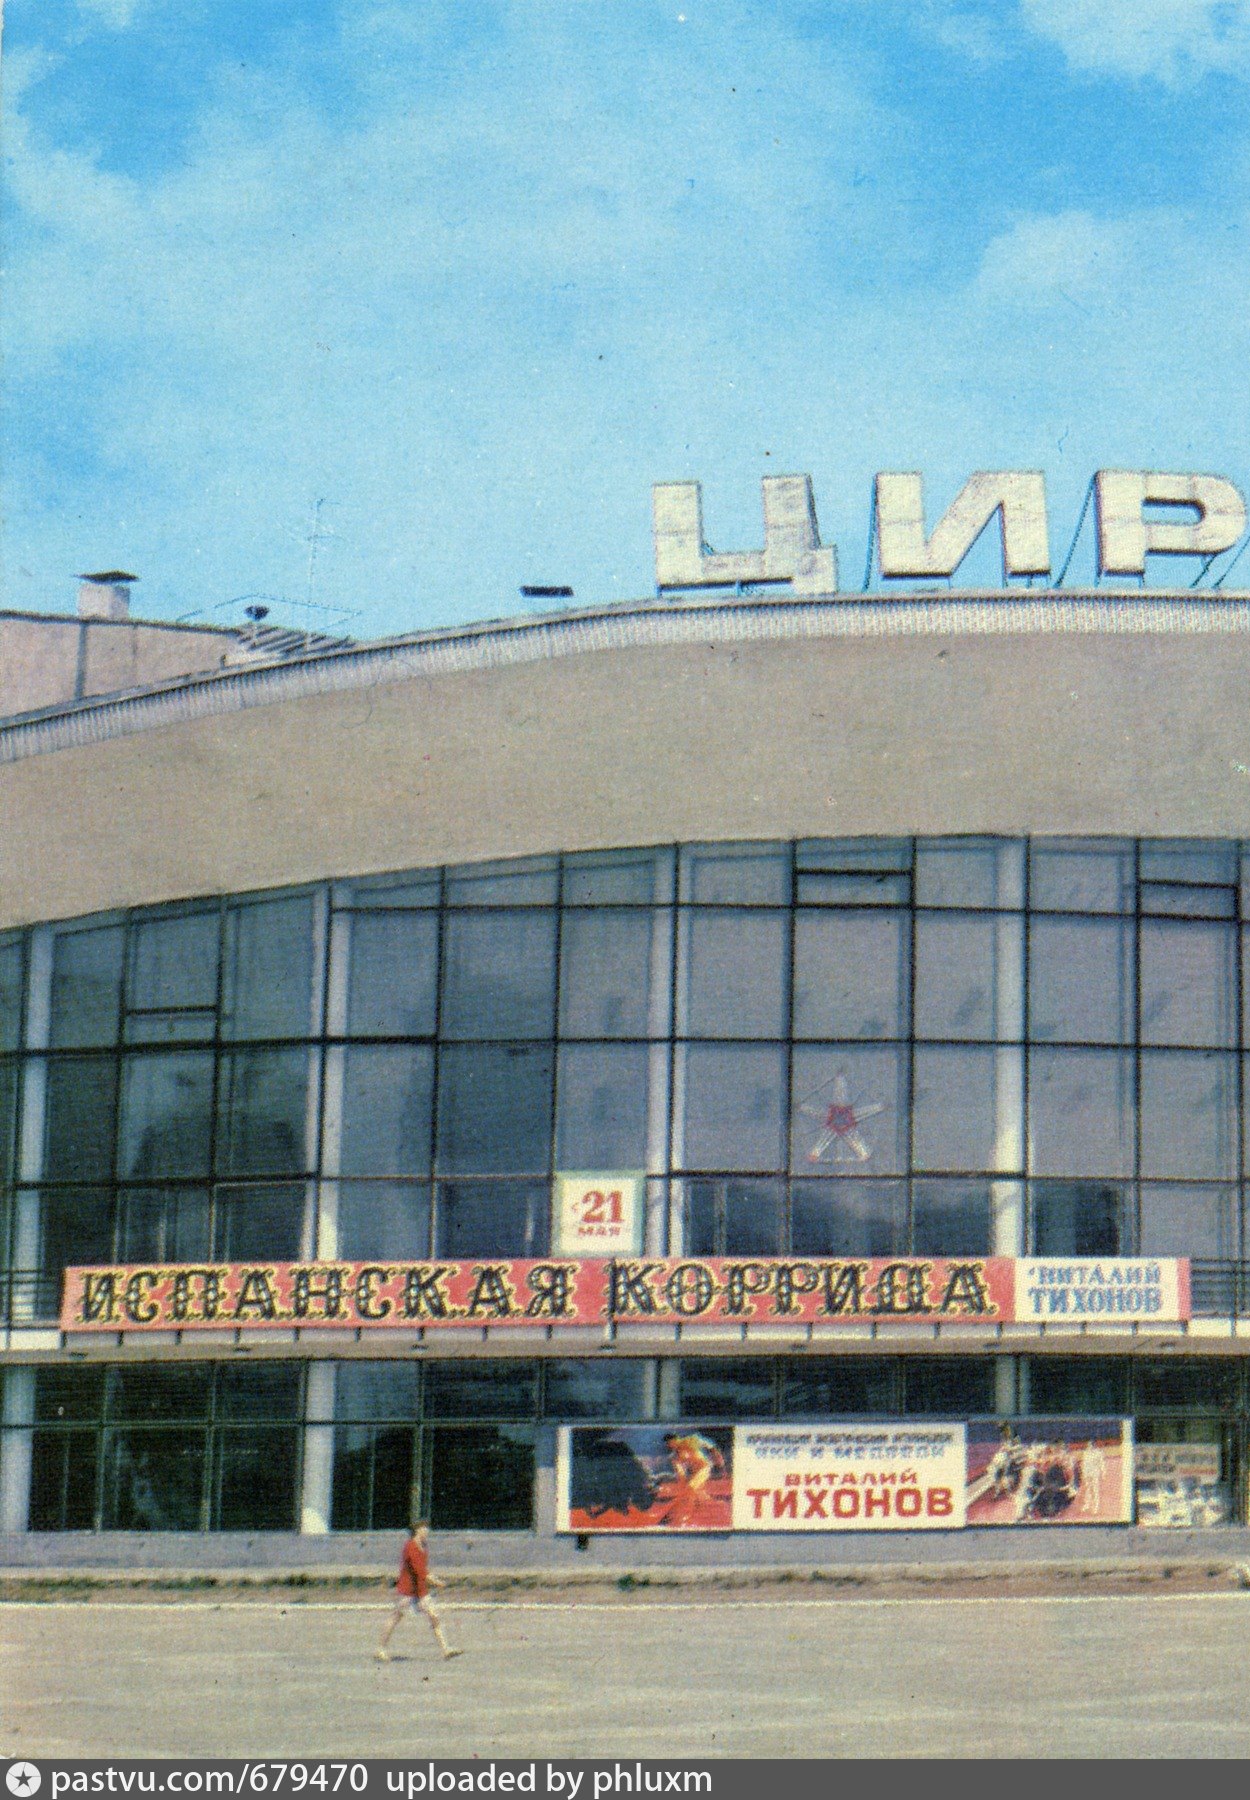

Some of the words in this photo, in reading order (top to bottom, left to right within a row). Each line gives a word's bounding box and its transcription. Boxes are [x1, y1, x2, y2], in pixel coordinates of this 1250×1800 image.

[581, 1190, 625, 1223] 21
[76, 1265, 580, 1325] ИСПАНСКАЯ
[602, 1260, 999, 1318] КОРРИДА
[1028, 1286, 1163, 1314] ТИХОНОВ
[785, 1468, 918, 1486] ВИТАЛИЙ
[746, 1487, 953, 1519] ТИХОНОВ
